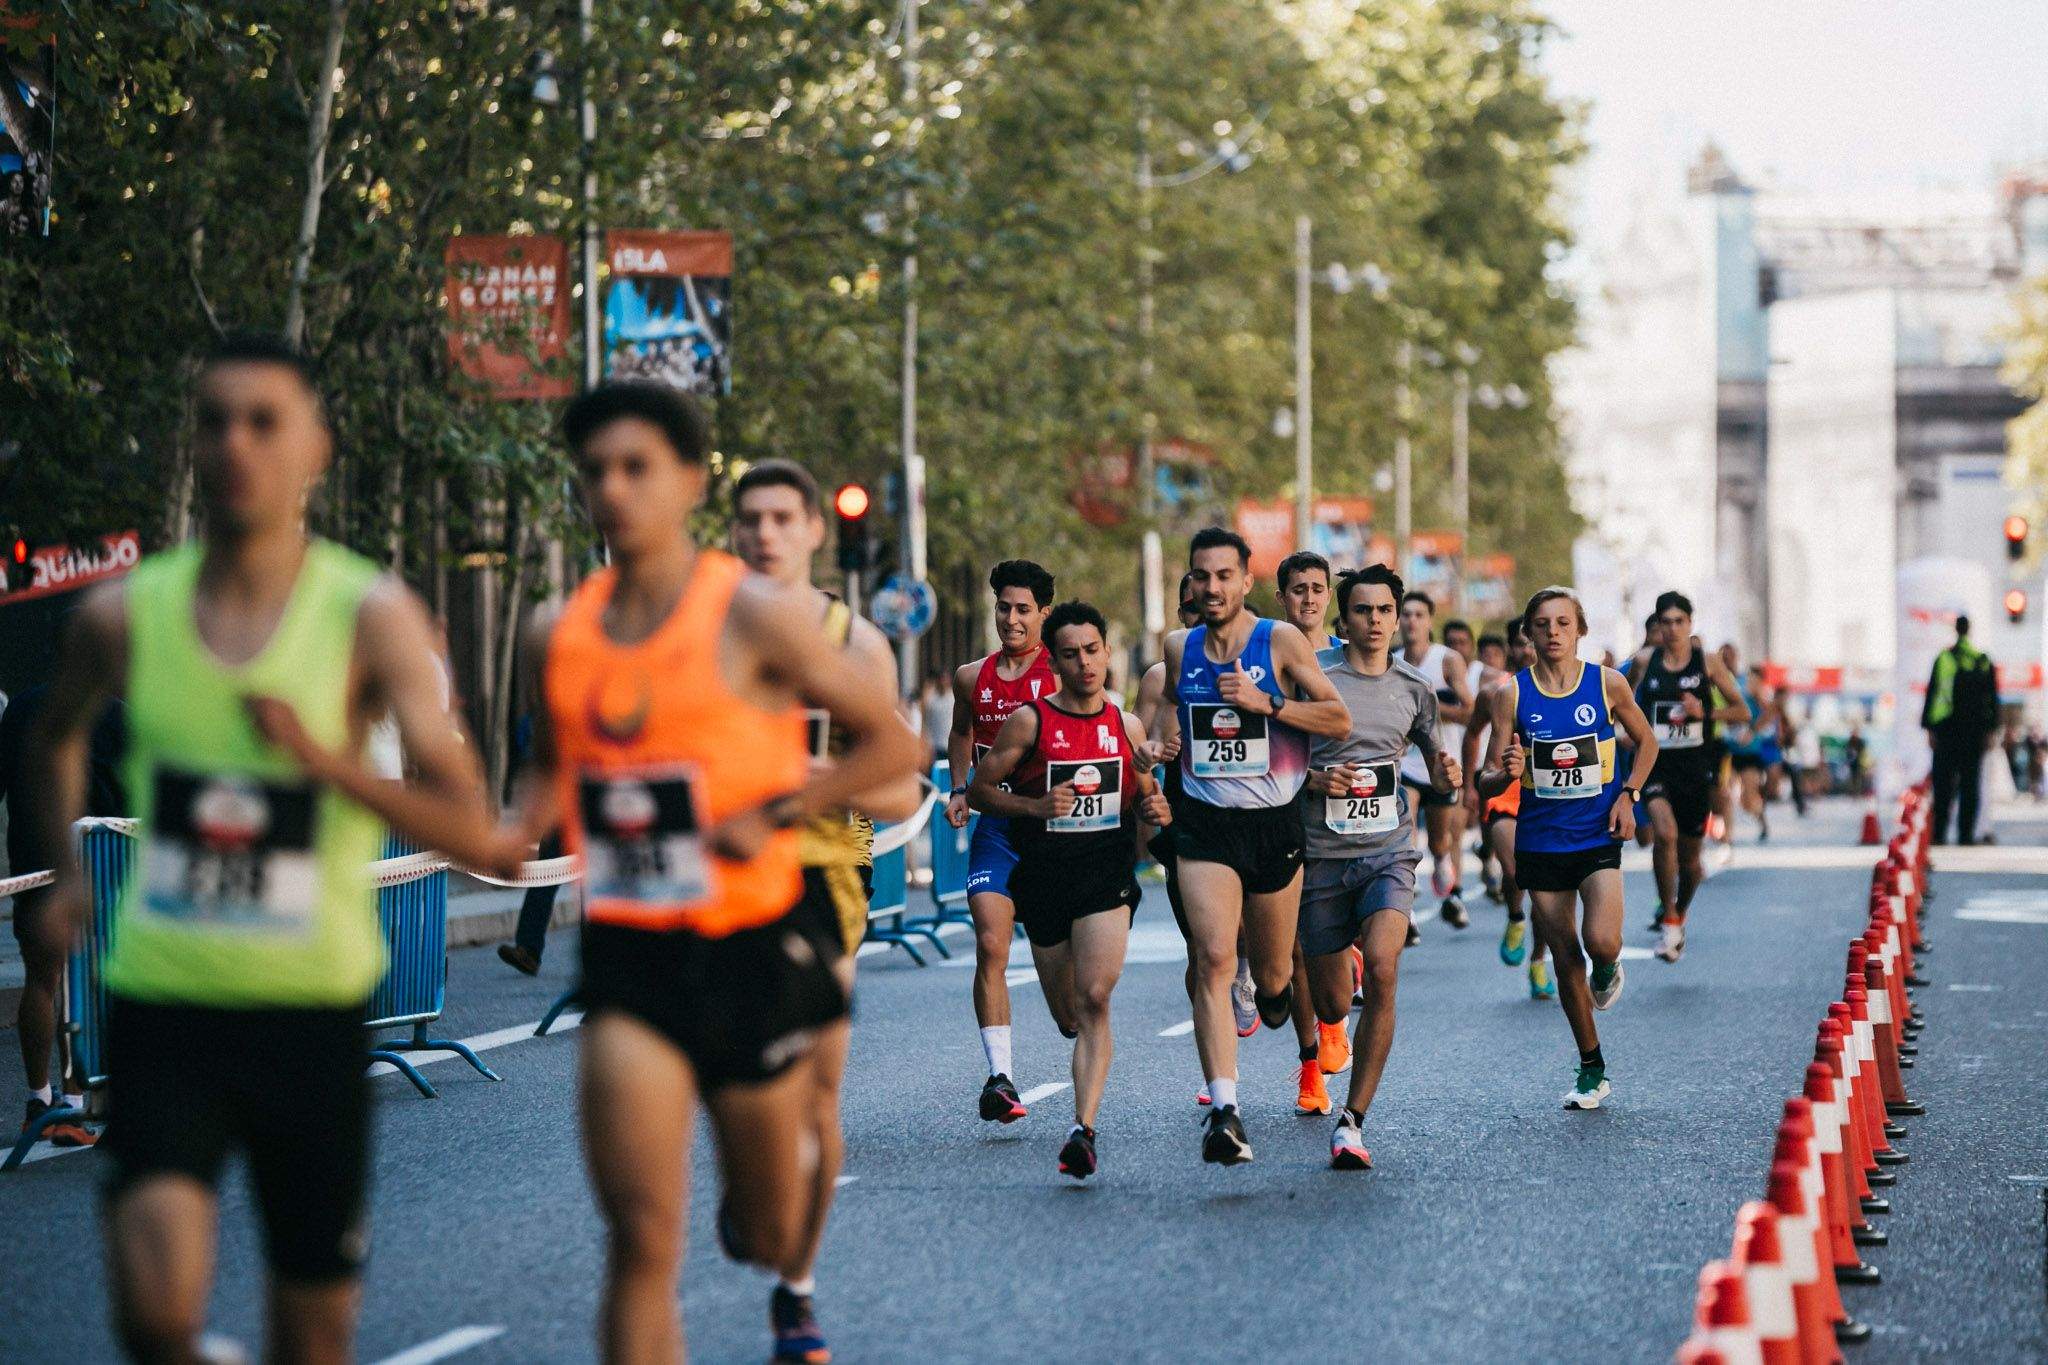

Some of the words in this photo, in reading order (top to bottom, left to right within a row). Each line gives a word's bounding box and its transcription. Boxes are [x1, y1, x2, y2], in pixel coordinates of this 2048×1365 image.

[616, 249, 669, 273] ISLA
[1208, 740, 1247, 763] 259
[1551, 768, 1583, 787] 278
[1071, 796, 1103, 818] 281
[1346, 798, 1380, 820] 245
